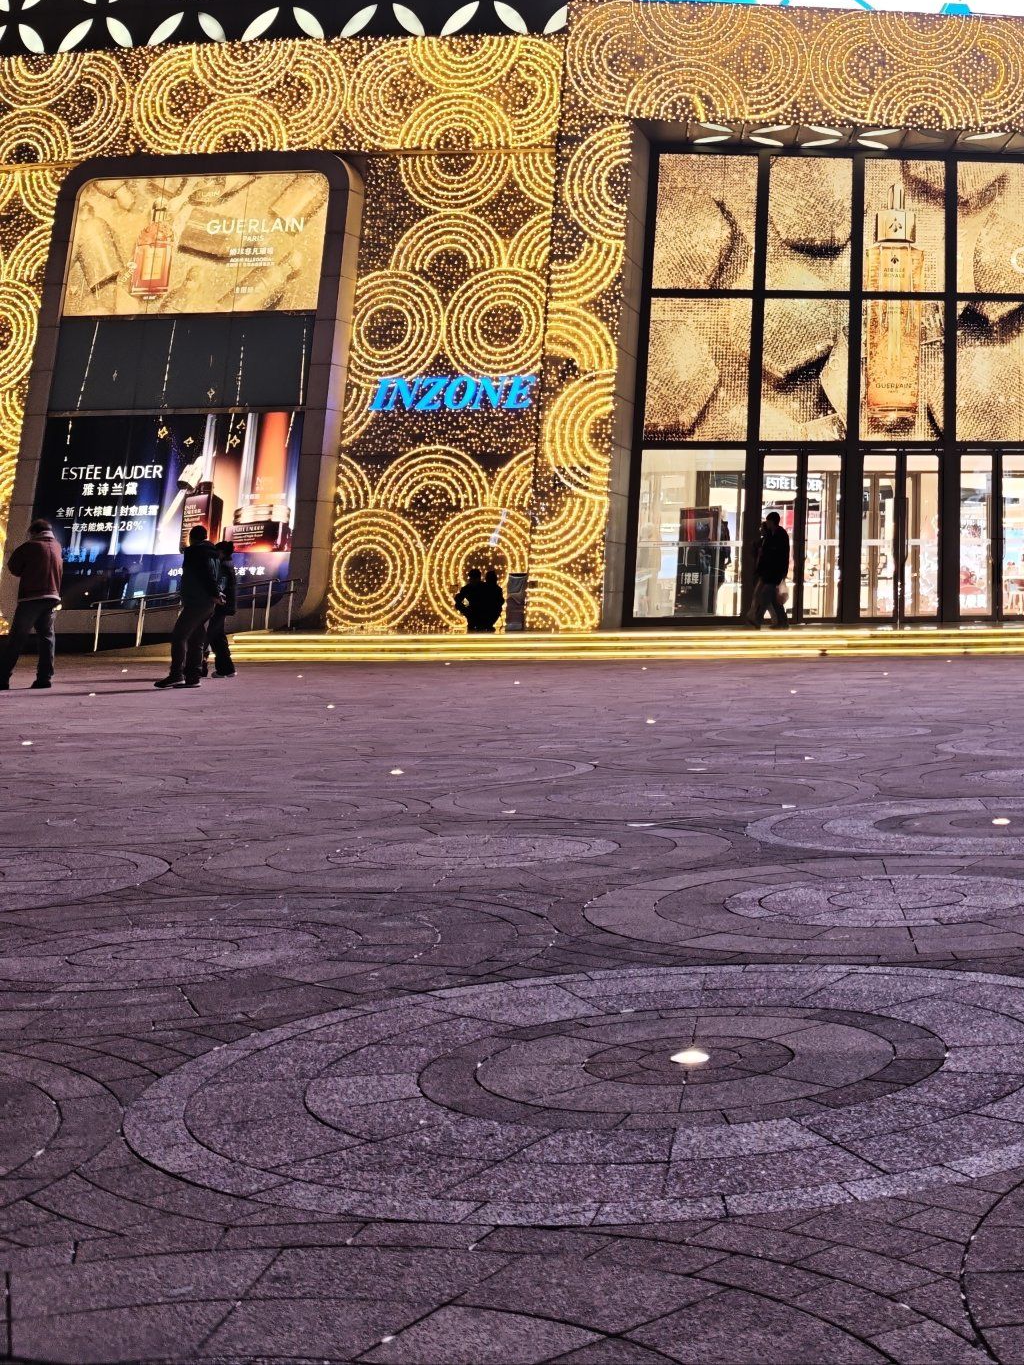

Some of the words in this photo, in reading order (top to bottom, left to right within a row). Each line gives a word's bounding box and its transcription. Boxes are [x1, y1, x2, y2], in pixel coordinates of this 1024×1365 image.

[206, 216, 305, 235] GUERLAIN
[368, 374, 537, 412] INZONE
[105, 465, 163, 480] LAUDER
[82, 481, 138, 496] 雅诗兰黛
